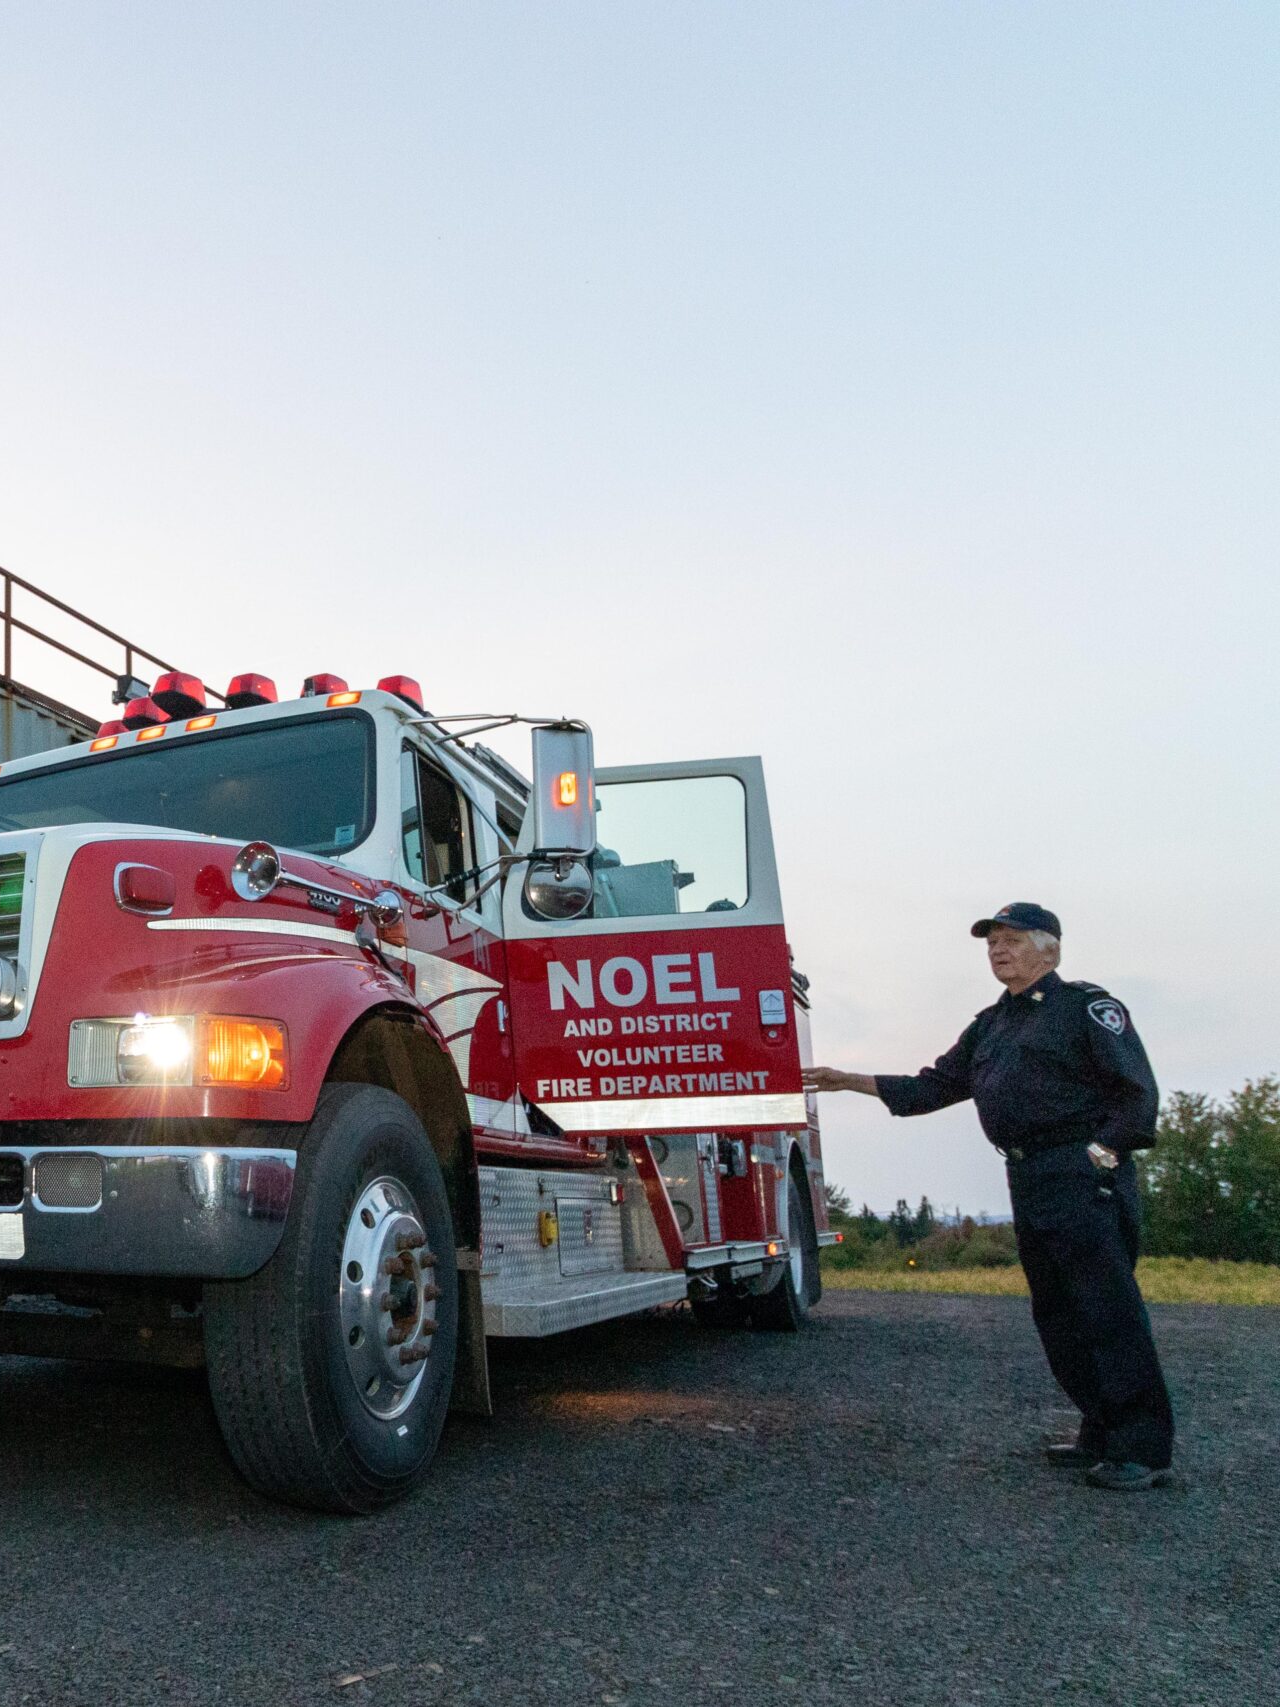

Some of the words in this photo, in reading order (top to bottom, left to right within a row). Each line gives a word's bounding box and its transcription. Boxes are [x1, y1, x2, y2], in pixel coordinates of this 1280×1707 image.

[546, 952, 741, 1010] NOEL
[563, 1017, 613, 1038] AND
[620, 1011, 732, 1035] DISTRICT
[577, 1043, 724, 1068] VOLUNTEER
[537, 1077, 592, 1098] FIRE
[600, 1071, 769, 1096] DEPARTMENT
